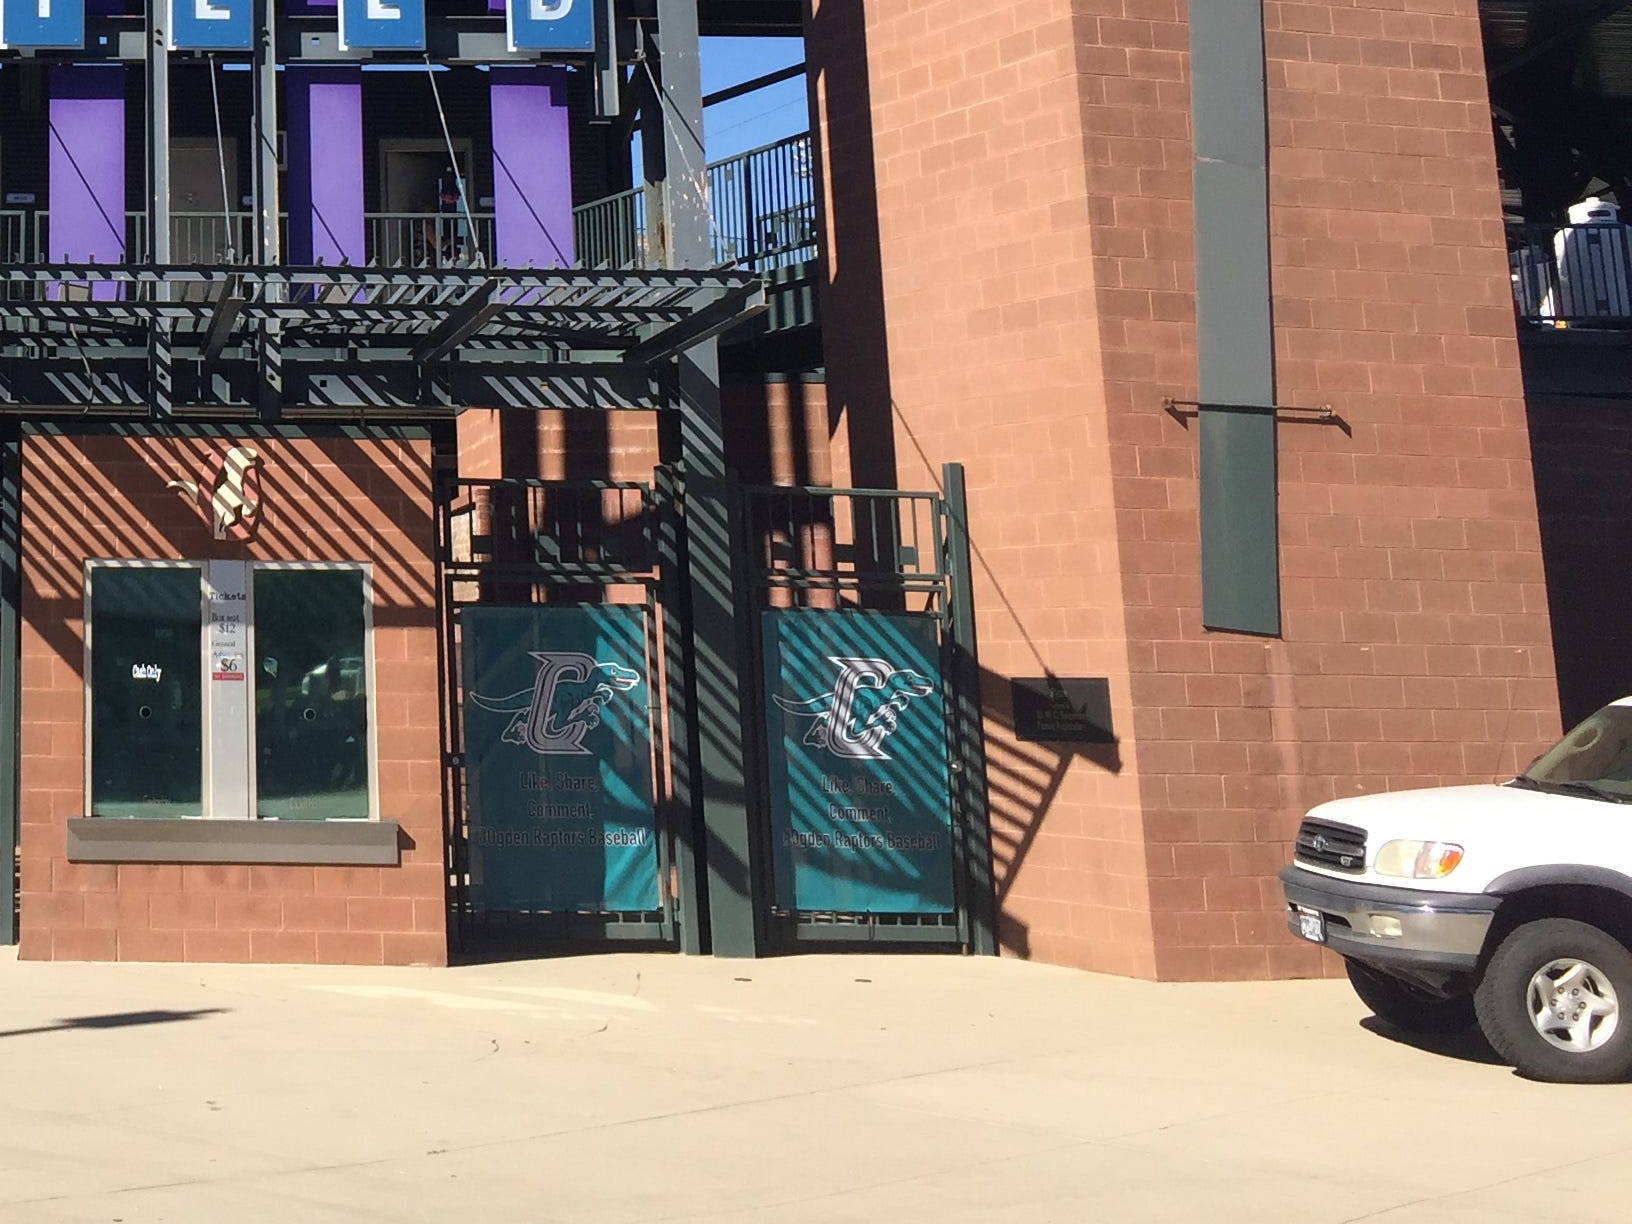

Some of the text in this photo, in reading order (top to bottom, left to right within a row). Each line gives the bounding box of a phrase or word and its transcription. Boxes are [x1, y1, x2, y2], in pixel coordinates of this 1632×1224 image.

[210, 592, 247, 601] Tickets
[219, 623, 236, 634] $12
[220, 658, 238, 673] $6
[533, 828, 585, 849] Raptors
[589, 826, 647, 847] Baseball
[834, 830, 883, 852] Raptors
[886, 830, 943, 851] Baseball
